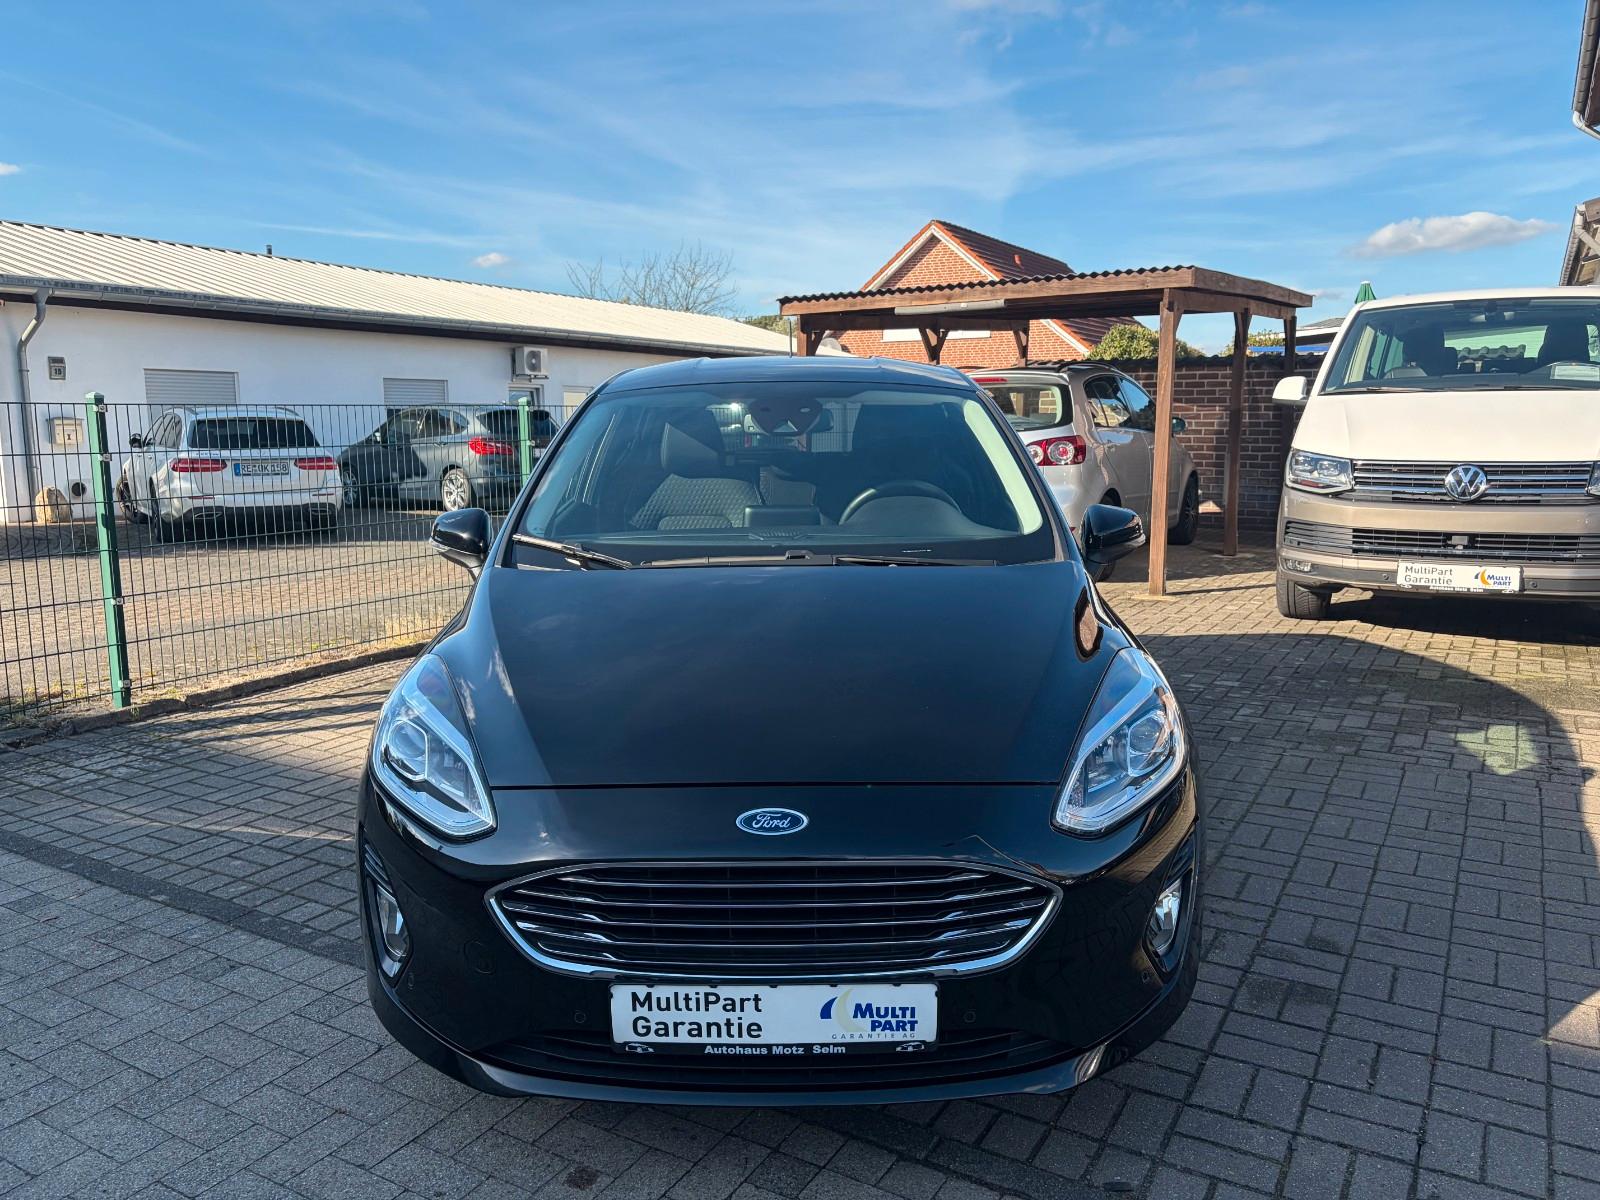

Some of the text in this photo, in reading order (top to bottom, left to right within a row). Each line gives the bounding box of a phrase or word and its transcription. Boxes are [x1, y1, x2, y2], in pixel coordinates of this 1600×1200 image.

[1405, 566, 1453, 576] MultiPart
[1404, 575, 1453, 586] Garantie
[752, 813, 791, 828] Ford
[631, 991, 763, 1013] MultiPart
[631, 1015, 763, 1039] Garantie
[870, 1020, 918, 1032] PART
[831, 1032, 895, 1040] GARANTIE
[704, 1044, 846, 1056] Autohaus Motz Selm
